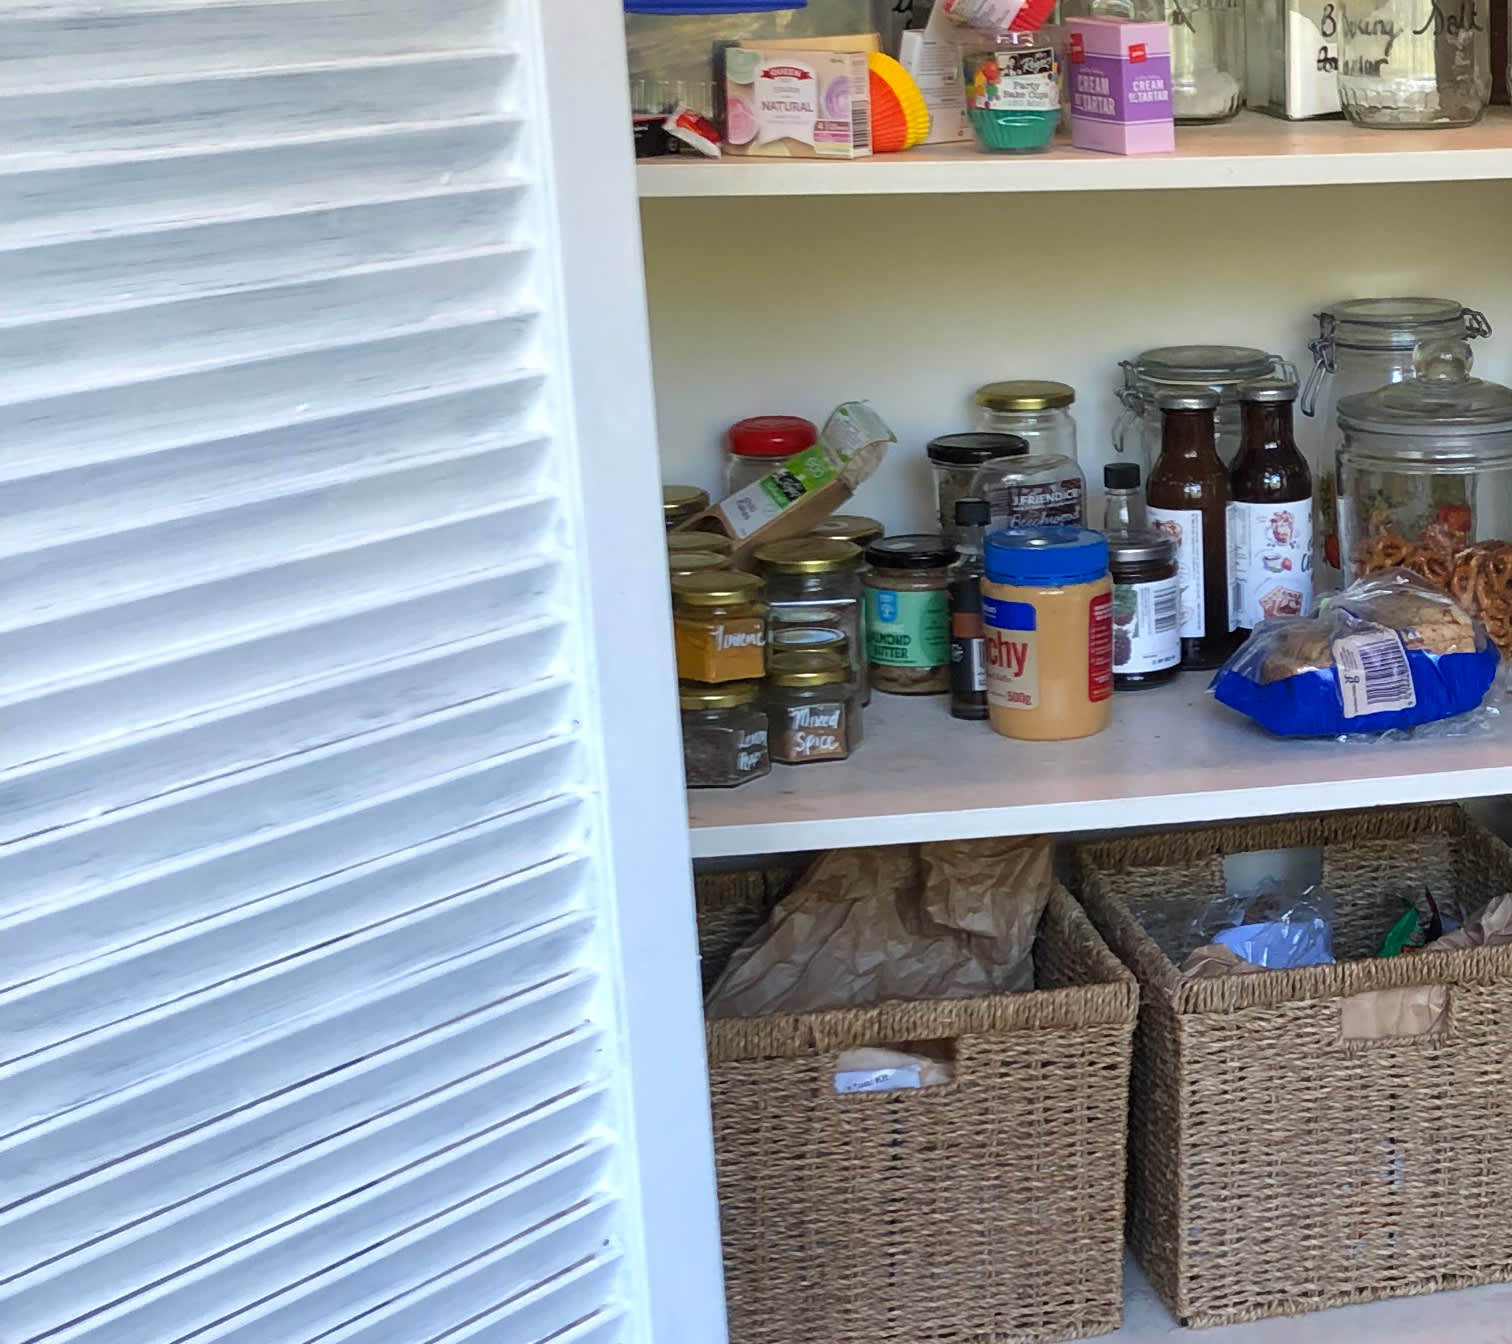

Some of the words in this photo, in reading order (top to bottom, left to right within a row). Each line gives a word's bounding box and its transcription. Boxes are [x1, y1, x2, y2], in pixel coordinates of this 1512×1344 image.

[1077, 74, 1110, 94] CREAM
[1132, 80, 1165, 92] CREAM
[1138, 91, 1169, 102] TARTAR
[761, 100, 814, 113] NATURAL
[1085, 97, 1116, 116] TARTAR
[793, 731, 839, 755] Spice
